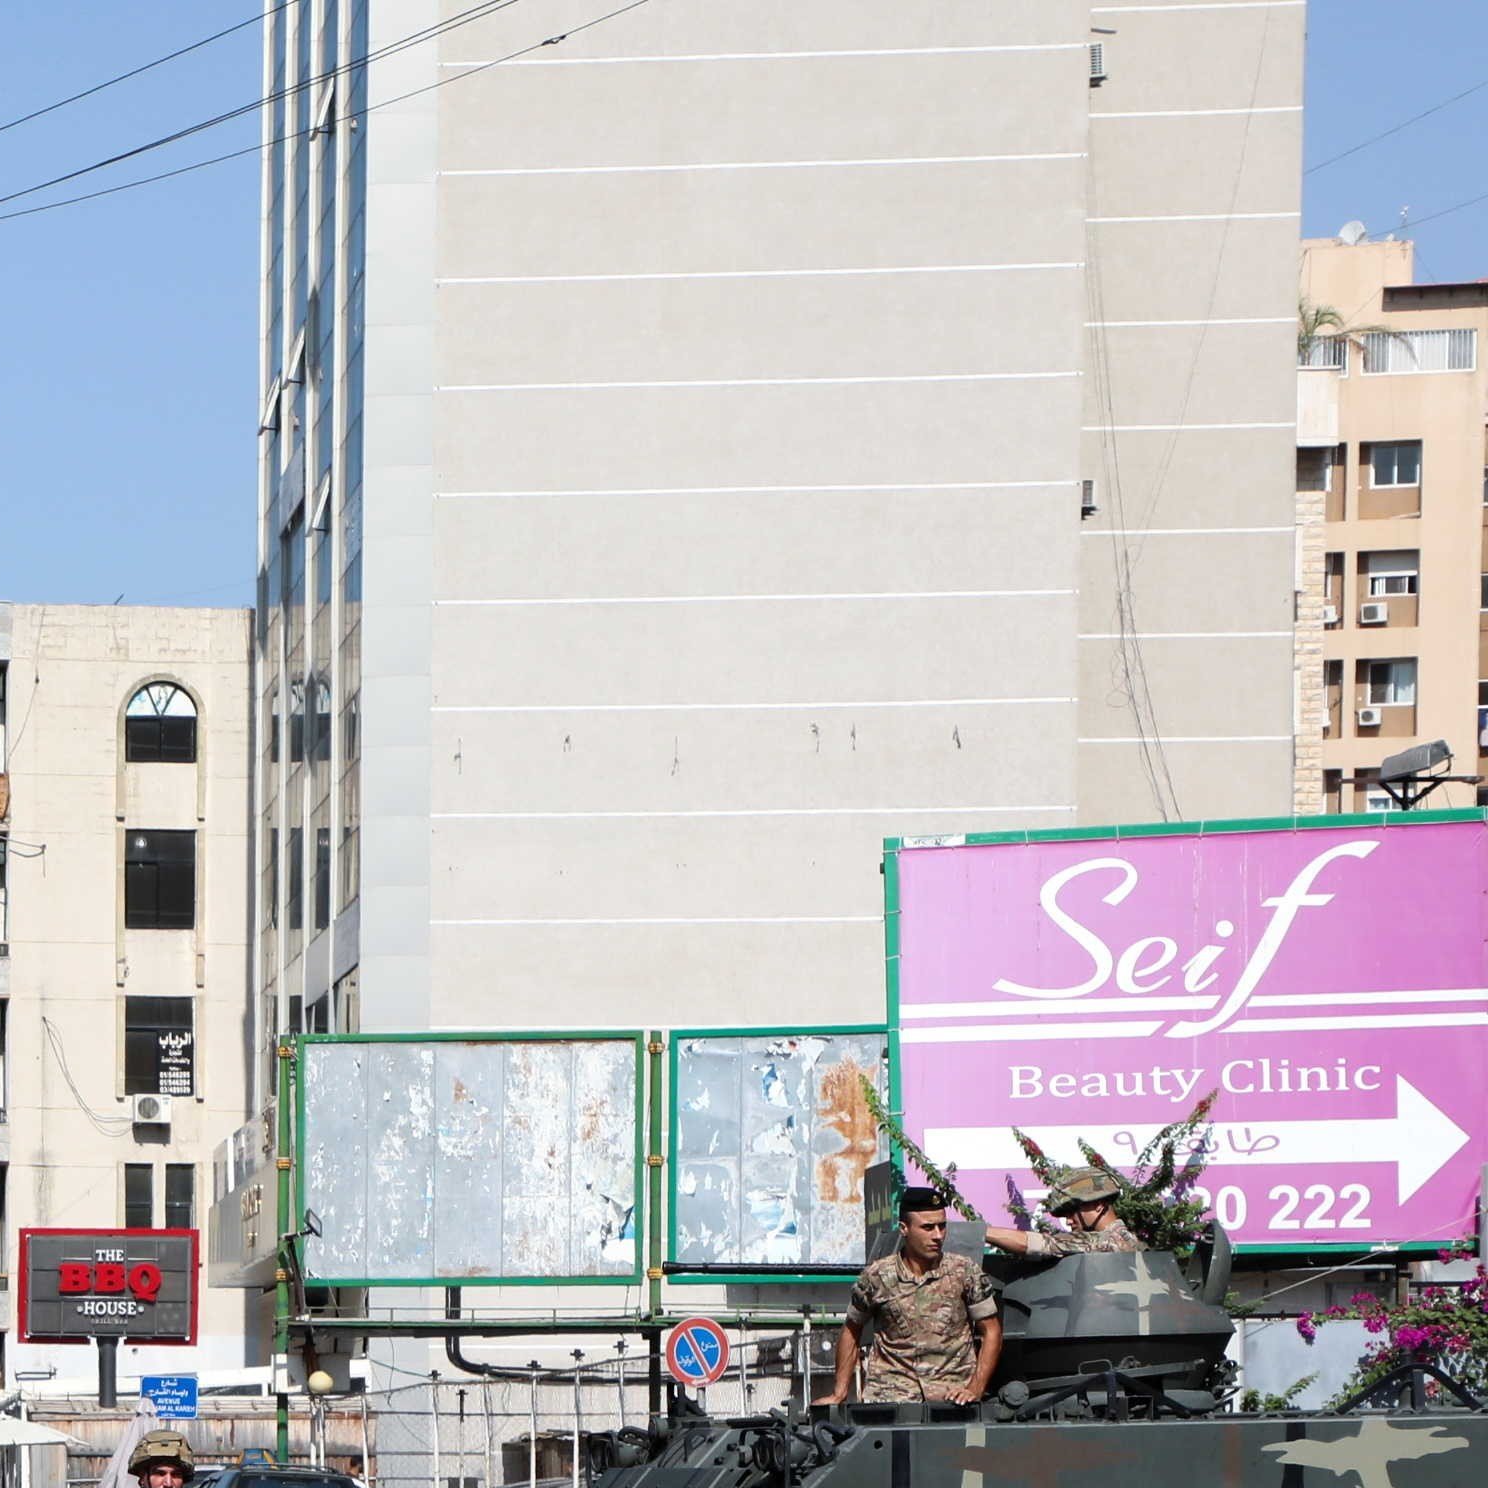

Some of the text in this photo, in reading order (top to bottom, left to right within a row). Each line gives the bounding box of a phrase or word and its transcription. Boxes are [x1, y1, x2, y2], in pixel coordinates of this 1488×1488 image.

[992, 841, 1381, 1038] Seif
[1008, 1058, 1381, 1102] Beauty Clinic
[1268, 1184, 1371, 1230] 222
[96, 1250, 124, 1262] THE
[58, 1263, 162, 1302] BBQ
[84, 1302, 136, 1315] HOUSE
